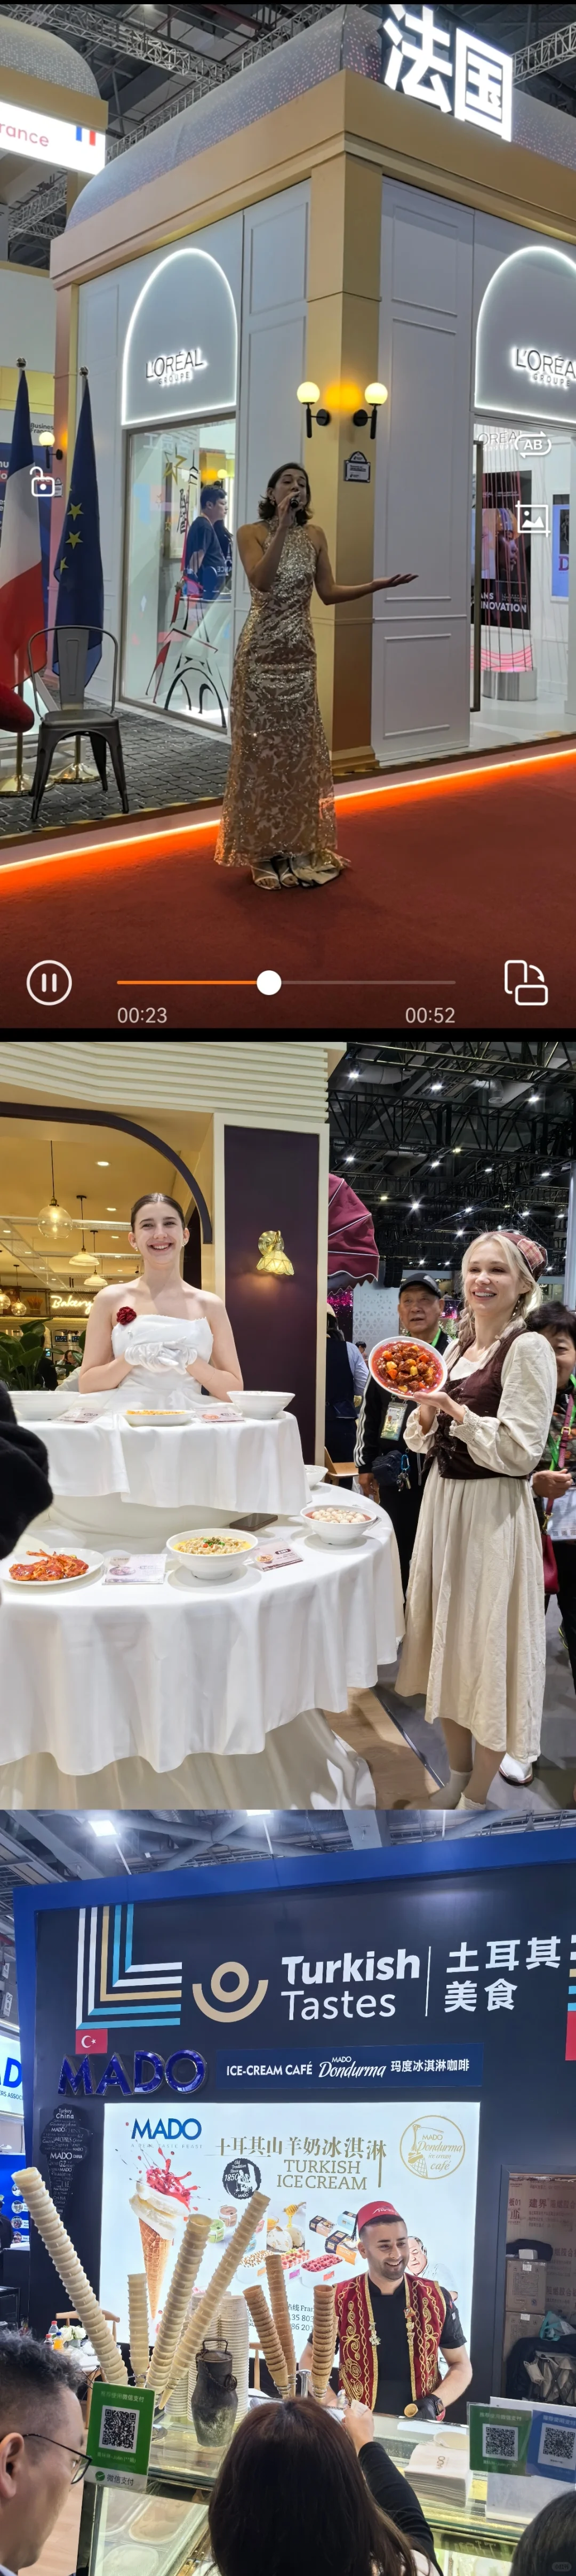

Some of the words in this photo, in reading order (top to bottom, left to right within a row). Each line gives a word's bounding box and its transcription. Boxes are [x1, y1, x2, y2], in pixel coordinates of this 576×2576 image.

[383, 4, 513, 142] 法国
[158, 372, 189, 384] GROUPE
[533, 373, 570, 387] GROUPE
[51, 1295, 94, 1314] Bakery
[446, 1936, 561, 1973] 土耳其
[282, 1949, 420, 1984] Turkish
[281, 1990, 396, 2020] Tastes
[444, 1978, 518, 2013] 美食
[58, 2049, 207, 2095] MADO
[227, 2065, 283, 2076] ICE-CREAM
[285, 2061, 313, 2075] CAFÉ
[318, 2061, 387, 2078] Dondurma
[390, 2059, 470, 2072] 玛度冰淇淋咖啡
[131, 2118, 202, 2140] MADO
[418, 2141, 463, 2152] Dondurma
[284, 2159, 361, 2174] TURKISH
[430, 2160, 451, 2172] café
[225, 2173, 239, 2181] 1850
[107, 2474, 134, 2486] 微信支付
